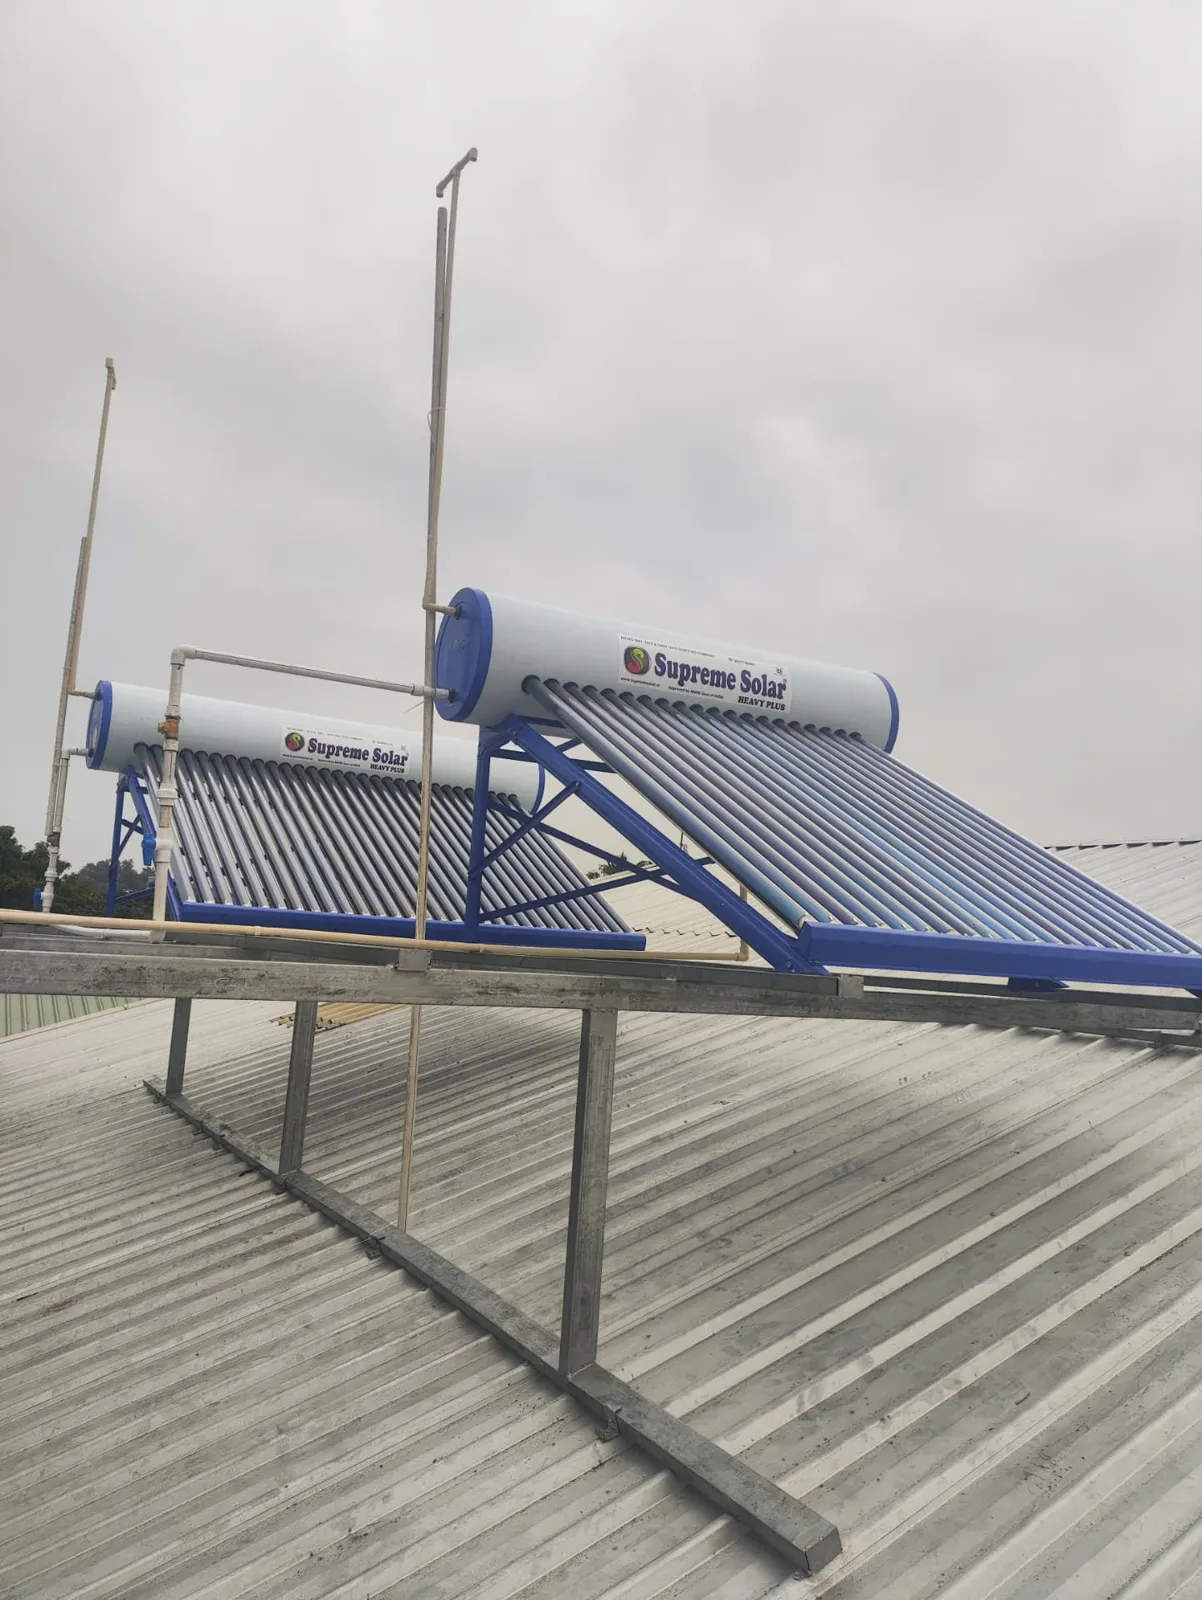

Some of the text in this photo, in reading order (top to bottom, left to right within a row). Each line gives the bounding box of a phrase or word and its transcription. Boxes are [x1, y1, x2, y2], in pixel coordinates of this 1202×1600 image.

[654, 652, 736, 690] Supreme
[740, 669, 787, 699] Solar
[737, 695, 786, 711] HEAVY PLUS
[307, 737, 369, 761] Supreme
[372, 747, 408, 766] Solar
[370, 763, 390, 771] HEAVY
